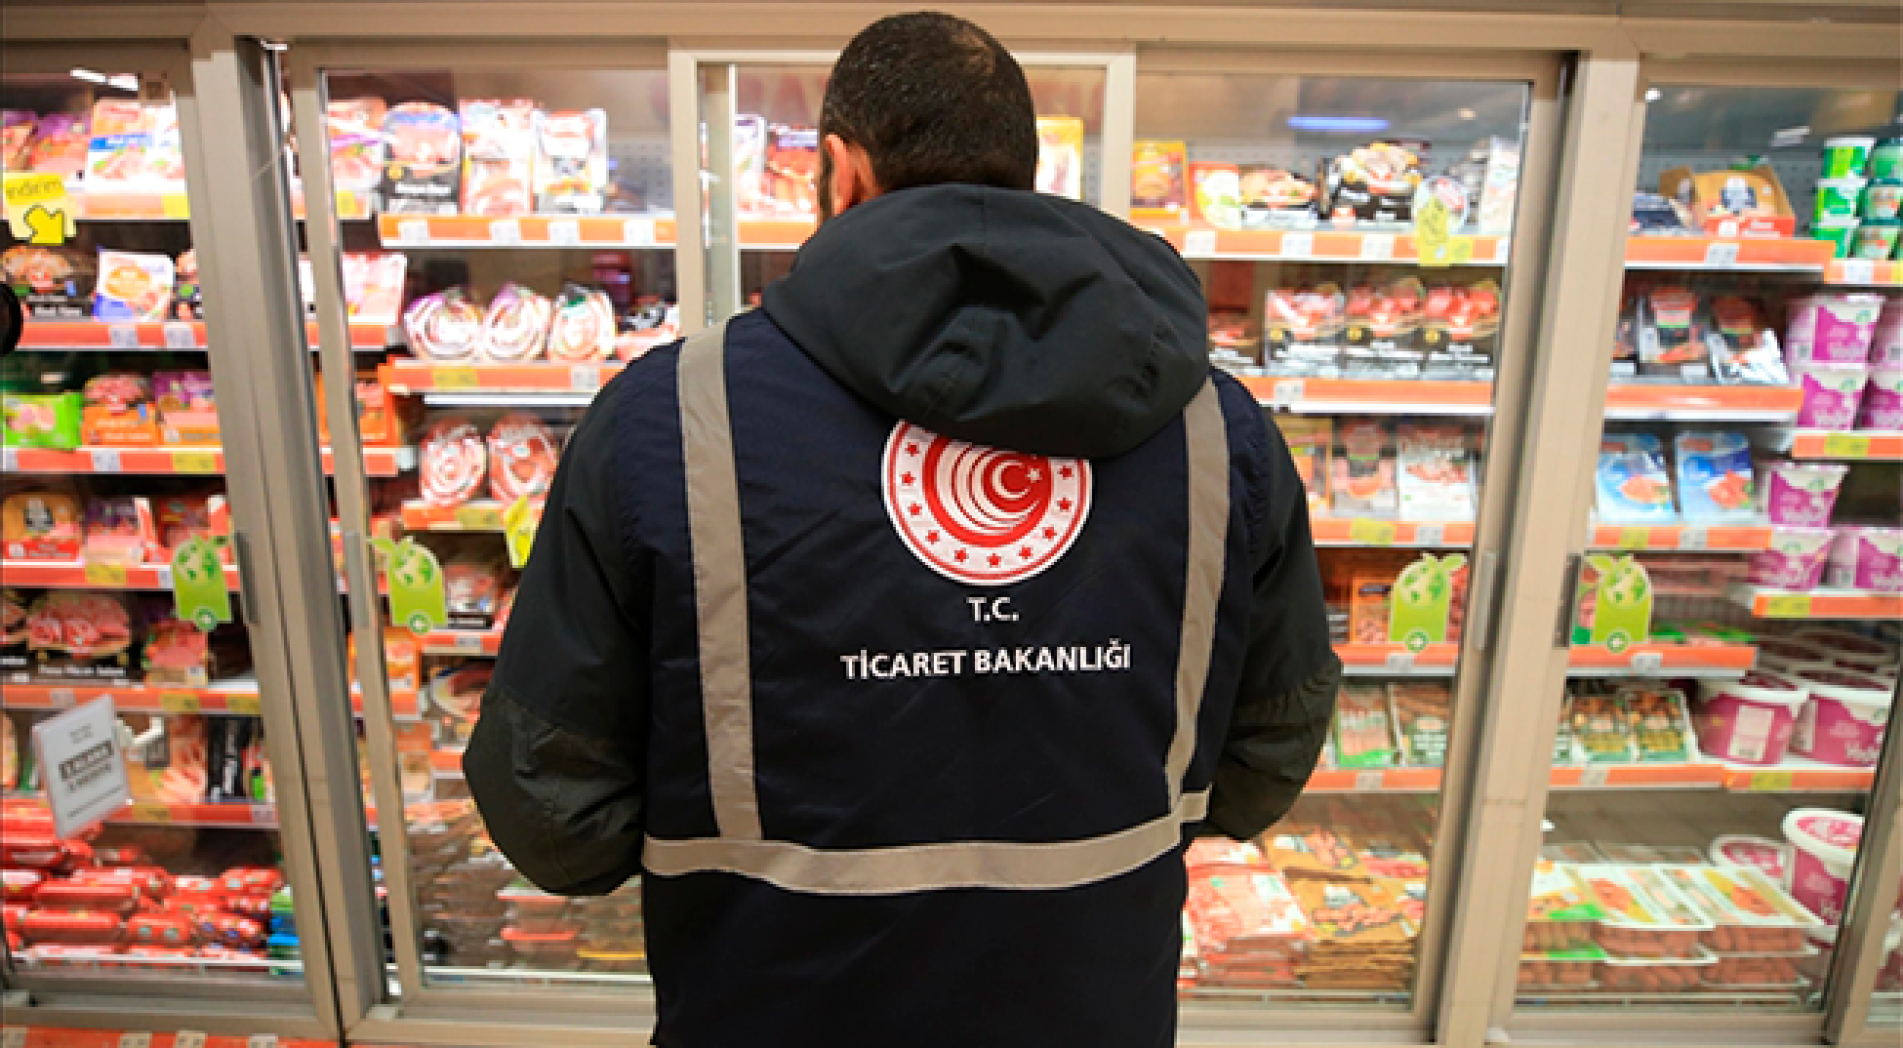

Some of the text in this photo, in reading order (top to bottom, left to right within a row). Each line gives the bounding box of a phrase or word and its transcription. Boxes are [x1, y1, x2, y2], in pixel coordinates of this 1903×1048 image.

[967, 596, 1020, 622] T.C.
[840, 638, 1131, 680] TİCARET BAKANLIĞI
